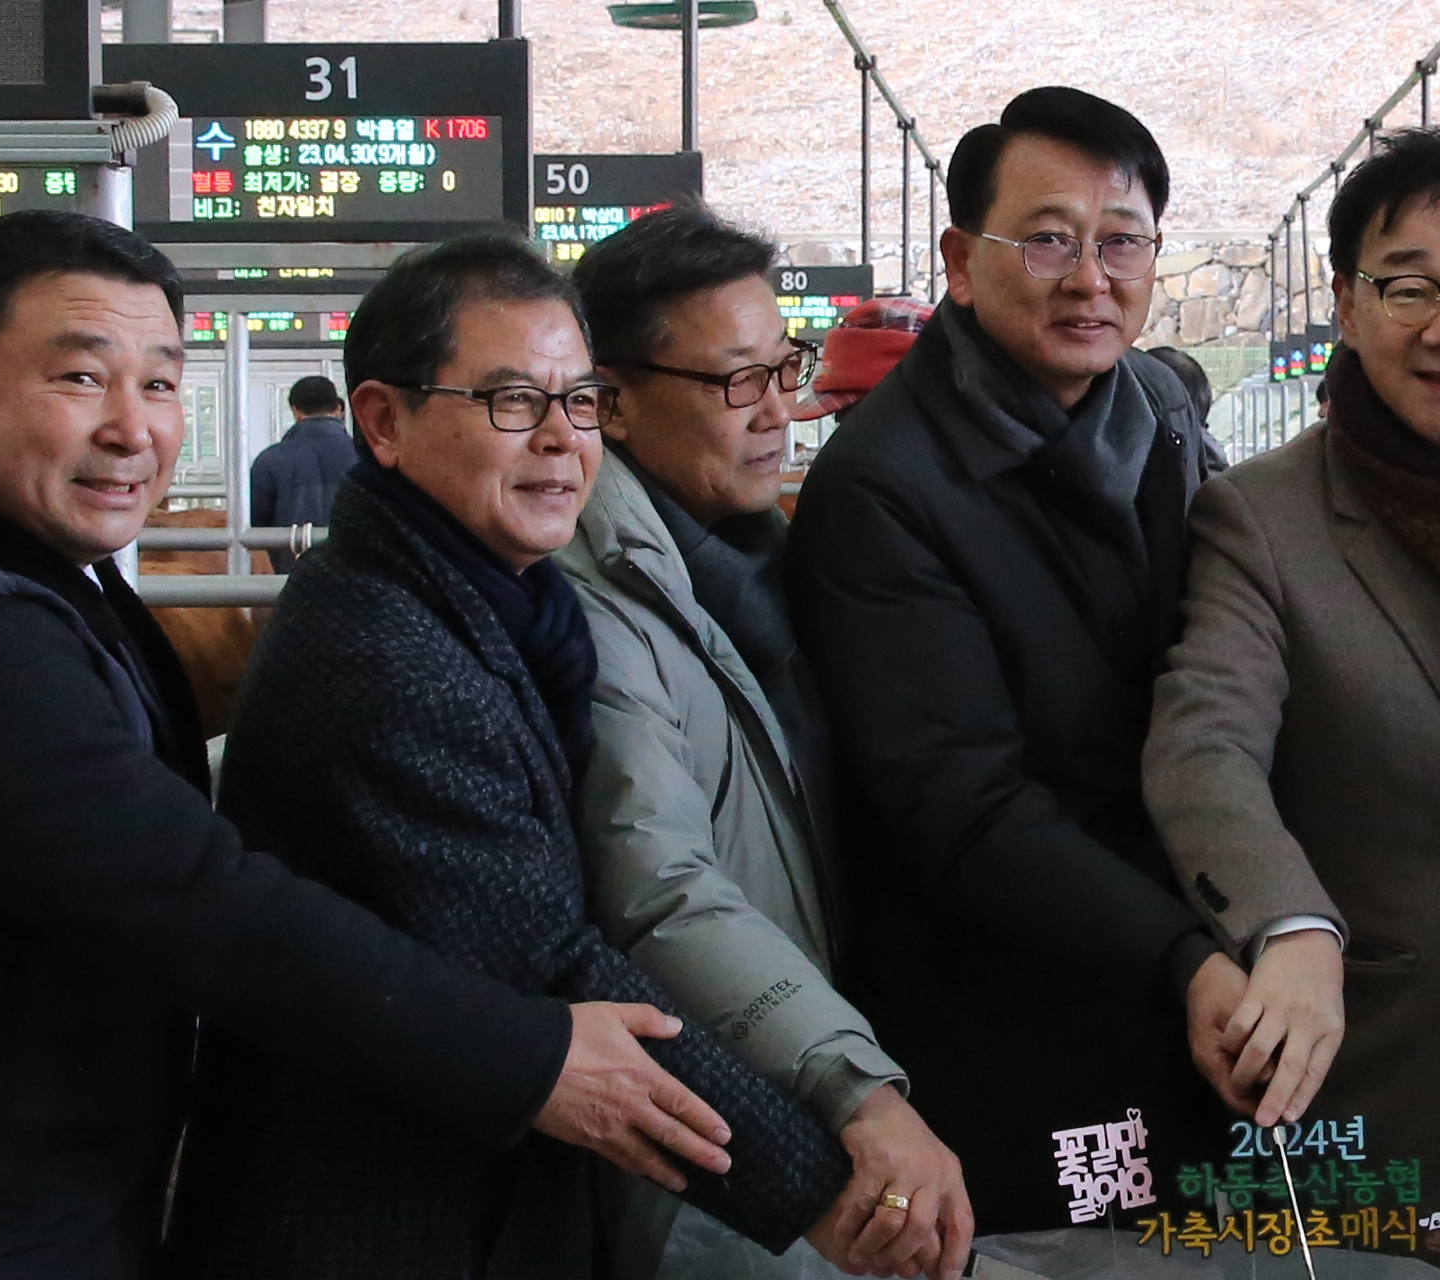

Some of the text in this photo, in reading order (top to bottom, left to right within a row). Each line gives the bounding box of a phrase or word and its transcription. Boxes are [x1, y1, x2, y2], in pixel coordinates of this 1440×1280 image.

[305, 56, 357, 101] 31
[288, 118, 489, 140] 4337 9 K 1706
[195, 121, 236, 162] 수
[243, 144, 290, 166] 출생:
[244, 171, 310, 193] 최저가:
[378, 170, 424, 193] 중량:
[442, 170, 455, 191] 0
[547, 163, 589, 195] 50
[193, 195, 334, 219] 비고: 친자일치
[781, 271, 808, 291] 80
